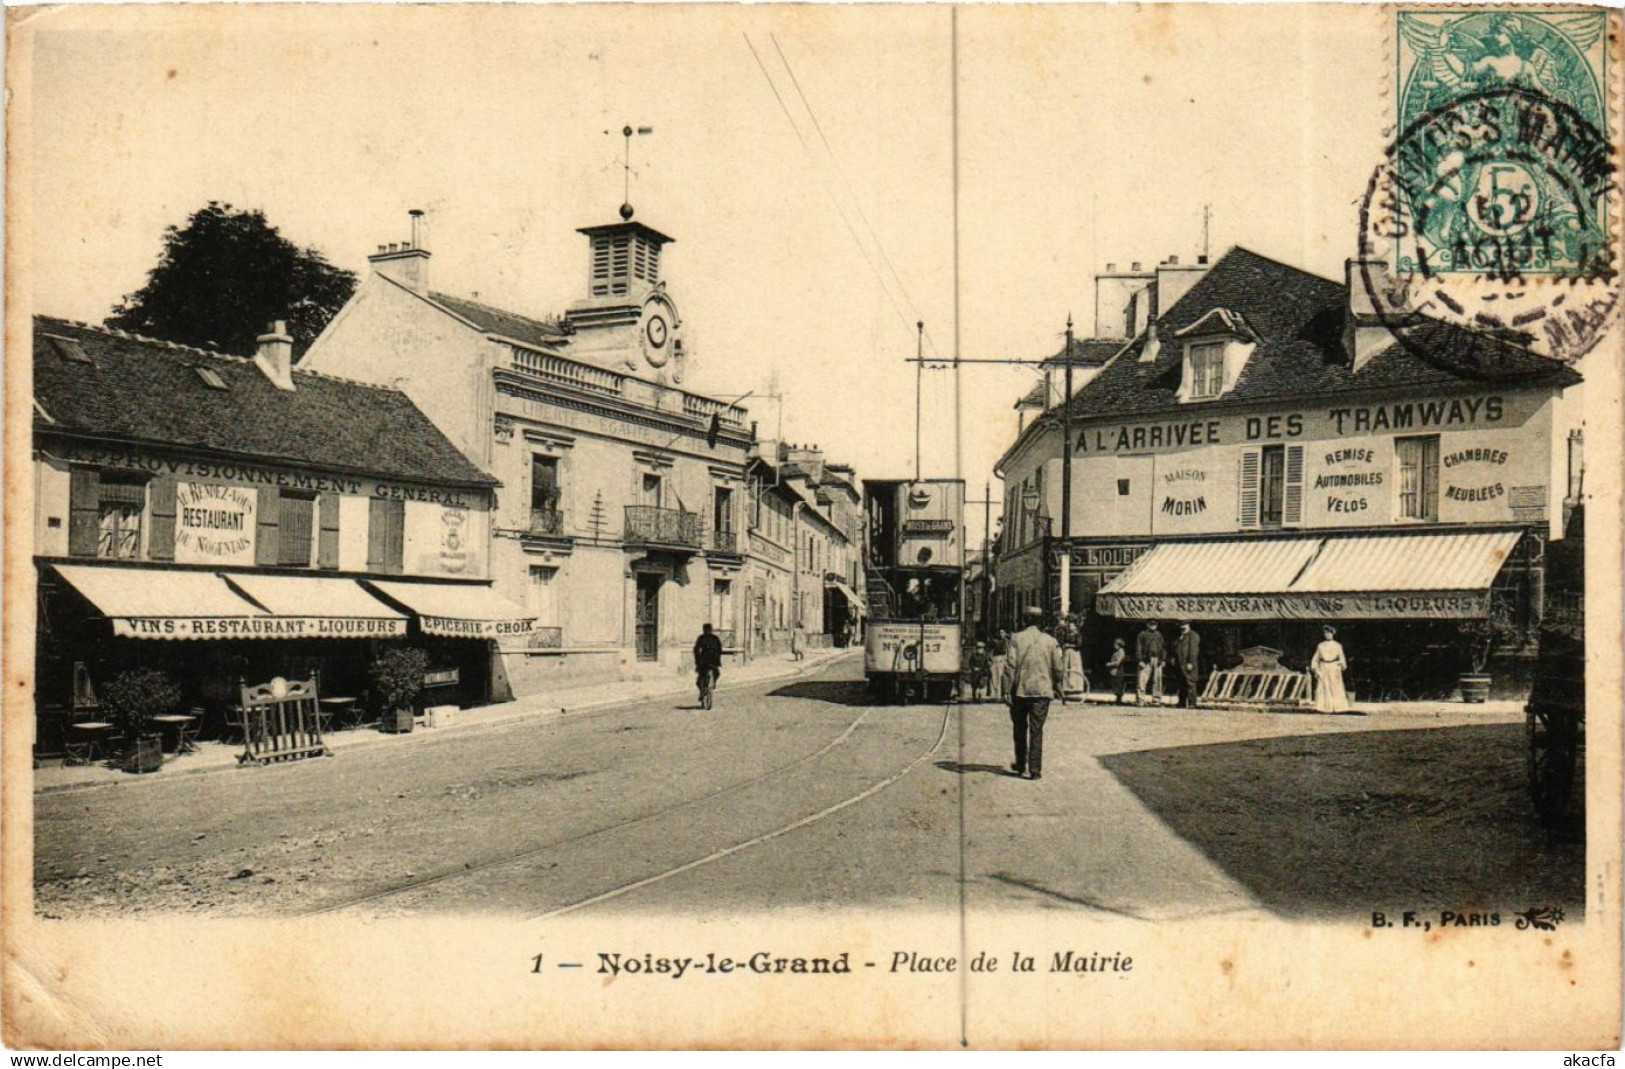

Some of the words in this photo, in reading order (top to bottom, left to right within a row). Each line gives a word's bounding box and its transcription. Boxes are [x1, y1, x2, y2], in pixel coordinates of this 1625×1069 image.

[1246, 413, 1304, 440] DES
[1330, 395, 1504, 436] TRAMWAYS
[1325, 448, 1374, 466] REMISE
[1443, 448, 1509, 468] CHAMBRES
[1164, 468, 1207, 484] MAISON
[1314, 472, 1383, 489] AUTOMOBILES
[1161, 495, 1207, 516] MORIN
[1327, 496, 1368, 513] VELOS
[183, 507, 245, 531] RESTAURANT
[128, 619, 174, 634] VINS
[192, 619, 306, 635] RESTAURANT
[319, 619, 397, 634] LIQUEURS
[424, 616, 483, 634] EPICERIE
[496, 620, 533, 634] CHOIX
